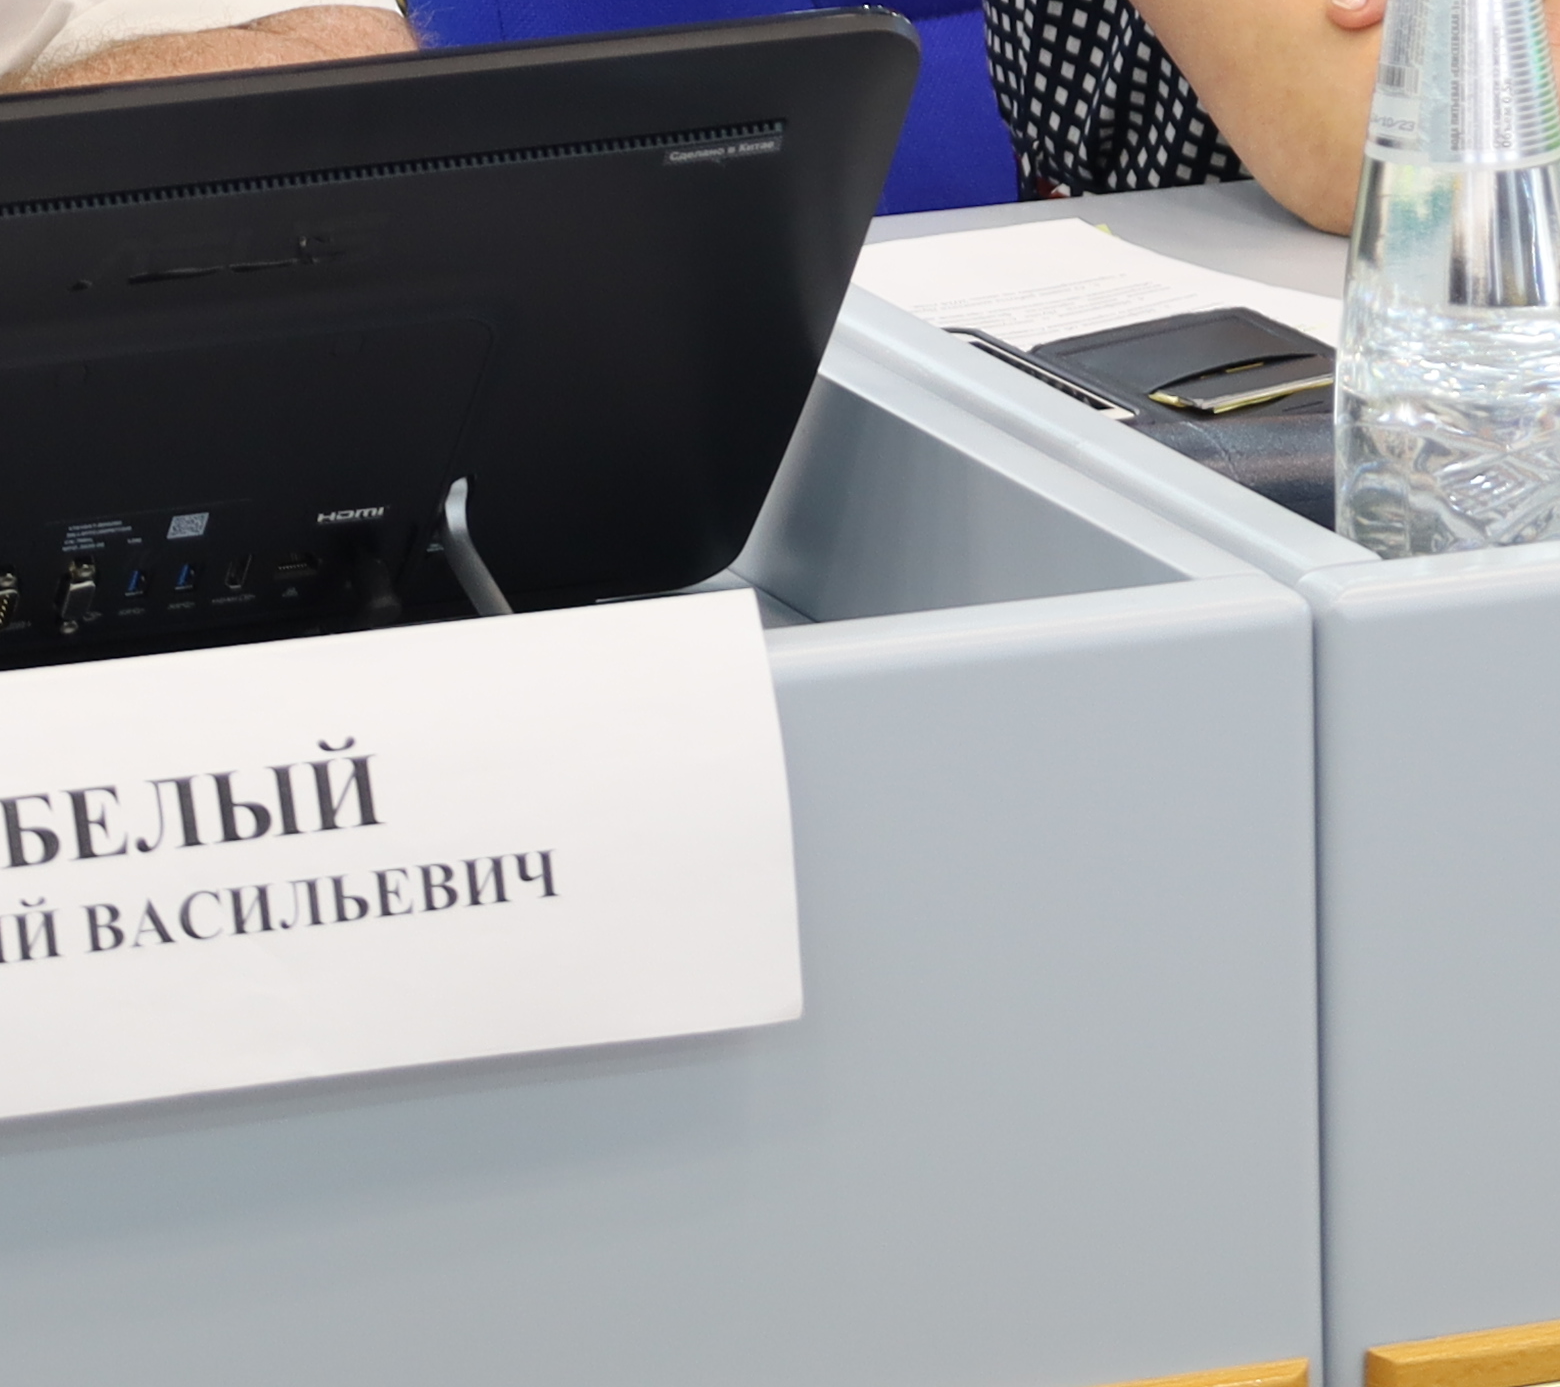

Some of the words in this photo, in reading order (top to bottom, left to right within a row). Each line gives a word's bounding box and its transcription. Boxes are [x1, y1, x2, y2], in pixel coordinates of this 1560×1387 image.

[1450, 79, 1460, 126] ПИТЬЕВАЯ
[1450, 127, 1460, 152] ВОДА
[1501, 107, 1513, 148] Объем
[669, 146, 726, 161] Сделано
[737, 140, 775, 153] Китае
[316, 506, 386, 523] HDMI
[84, 848, 561, 955] ВАСИЛЬЕВИЧ
